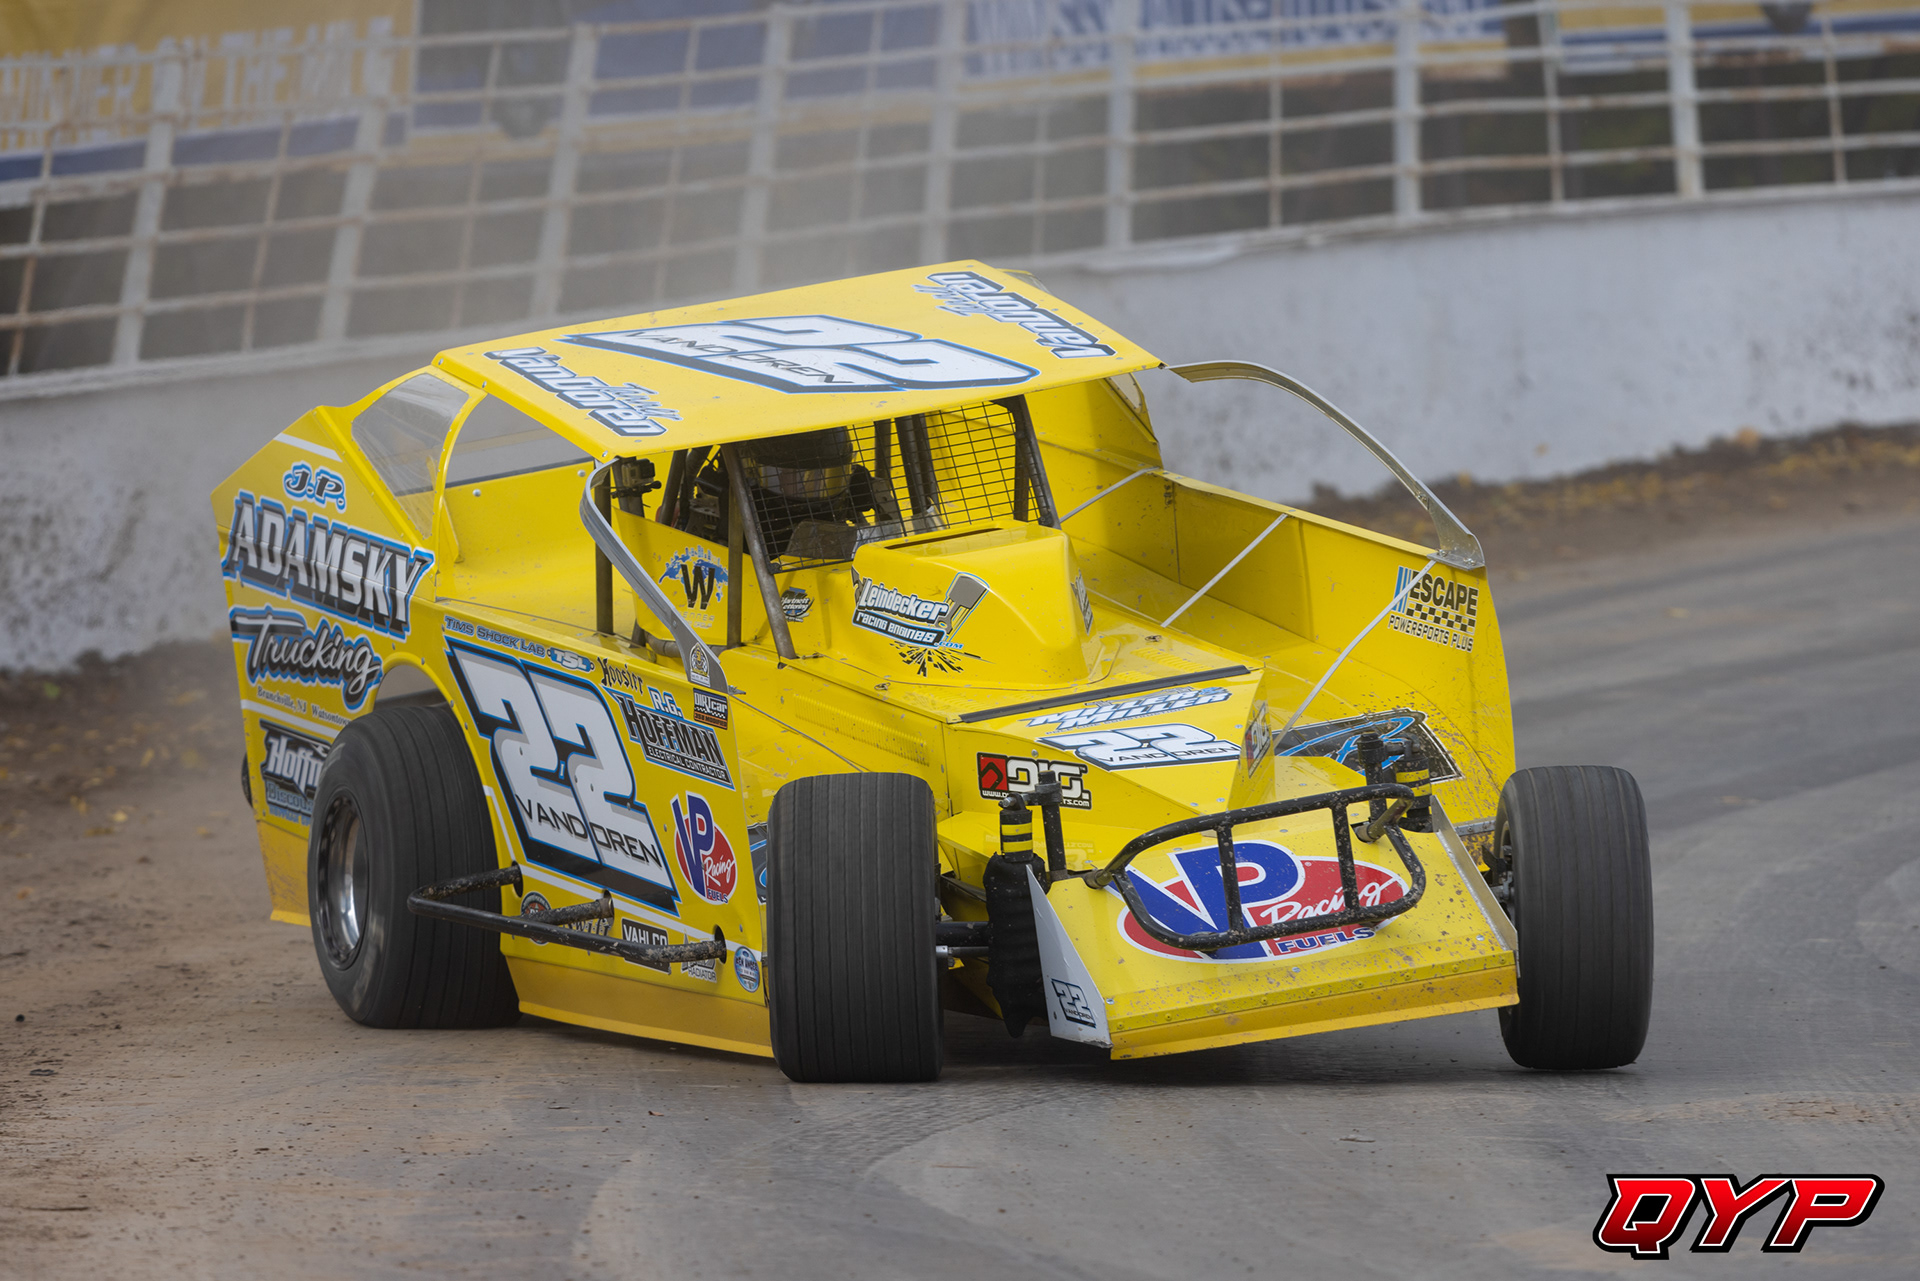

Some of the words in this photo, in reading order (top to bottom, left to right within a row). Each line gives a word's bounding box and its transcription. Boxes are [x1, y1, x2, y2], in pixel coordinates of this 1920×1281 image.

[553, 315, 1040, 394] 22
[483, 347, 667, 437] VanDoren
[284, 461, 346, 513] J.P.
[225, 492, 434, 634] ADAMSKY
[681, 564, 716, 610] W
[859, 579, 949, 624] Leindecker
[1409, 570, 1479, 617] ESCAPE
[445, 615, 474, 636] TIMS
[477, 625, 519, 650] SHOCK
[520, 637, 546, 658] LAB
[1388, 614, 1450, 647] POWERSPORTS
[1450, 631, 1475, 653] PLUS
[232, 609, 383, 705] Trucking
[553, 649, 588, 670] TSL
[597, 657, 643, 695] Hoosier
[311, 702, 352, 727] Watsontow
[649, 687, 683, 718] R.G.
[1021, 690, 1201, 727] MILLER
[1057, 692, 1232, 730] MILLER
[614, 693, 726, 767] HOFFMAN
[1034, 723, 1241, 771] 22
[444, 637, 680, 916] 22
[648, 746, 685, 767] ELECTRICAL
[685, 757, 727, 781] CONTRACTOR
[670, 791, 714, 898] VP
[703, 854, 735, 887] Racing
[707, 888, 728, 904] FUELS
[1104, 841, 1303, 958] VP
[1260, 881, 1396, 925] Racig
[1276, 927, 1376, 953] FUELS
[688, 967, 717, 983] RADIATOR
[1051, 978, 1096, 1028] 22
